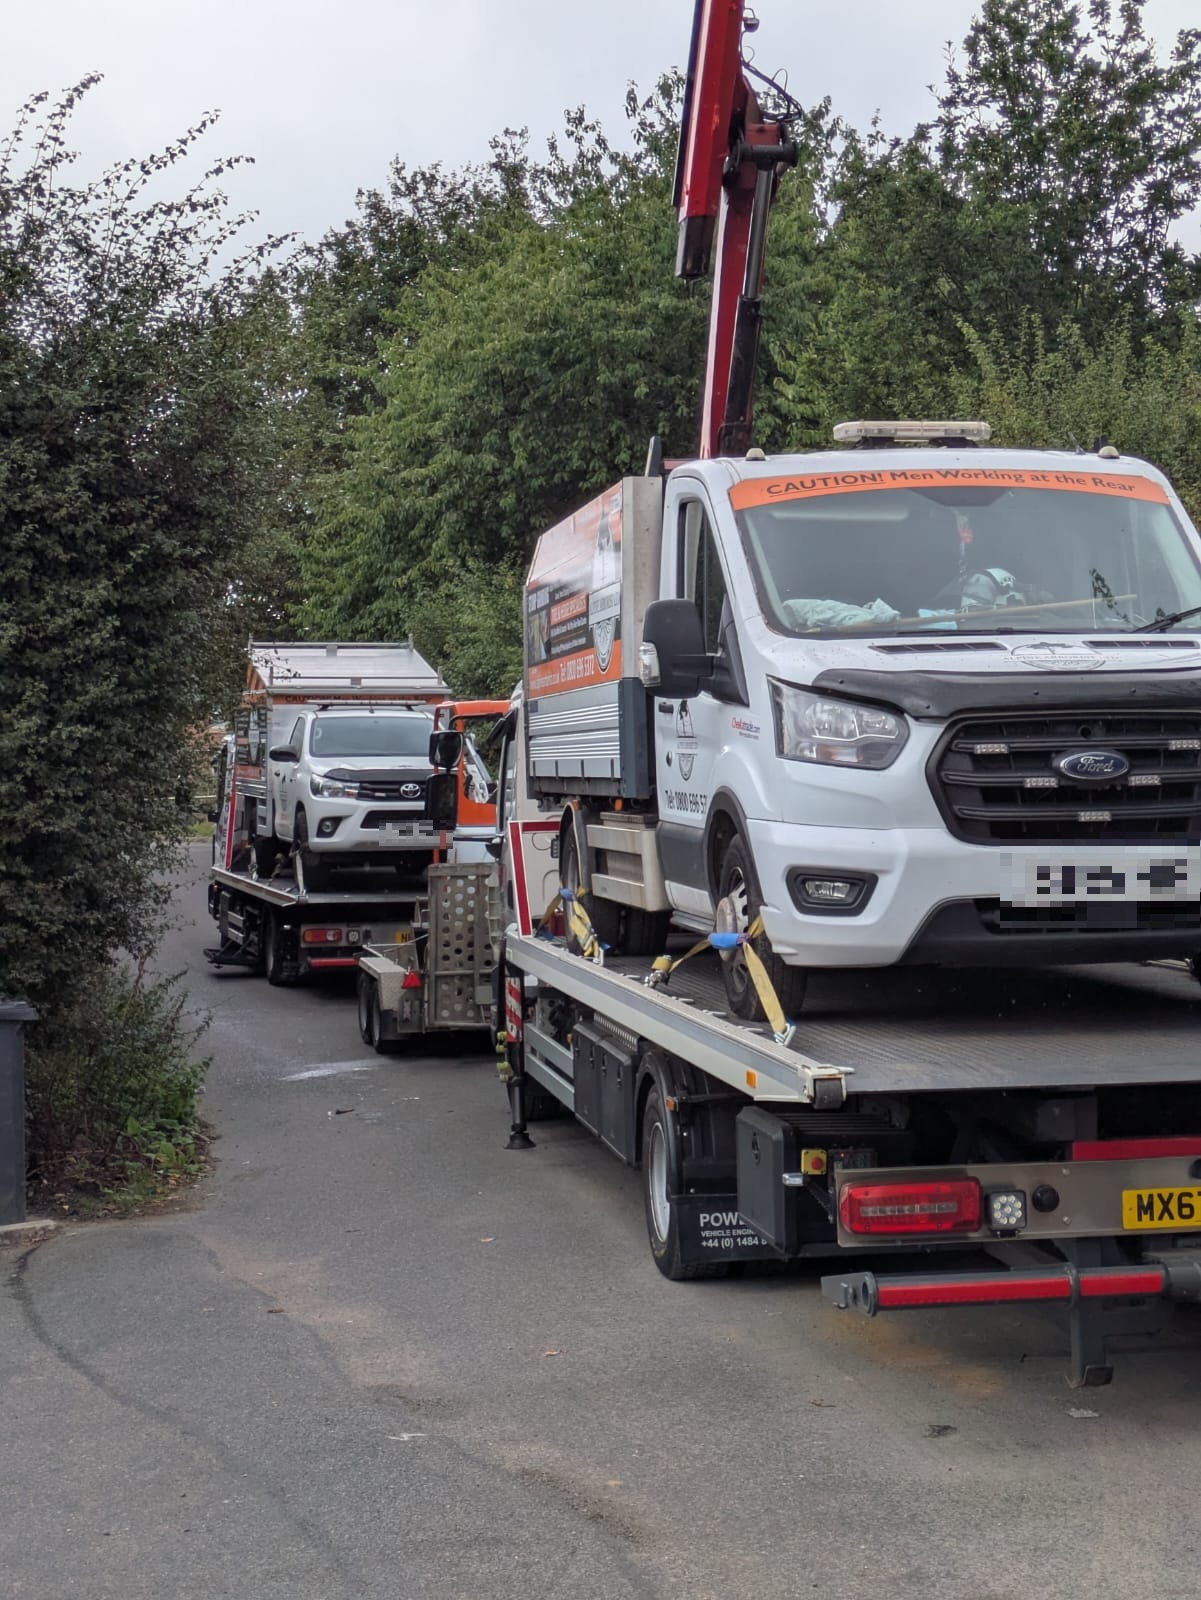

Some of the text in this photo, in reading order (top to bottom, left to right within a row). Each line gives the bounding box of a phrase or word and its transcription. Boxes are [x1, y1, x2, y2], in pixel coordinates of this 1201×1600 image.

[766, 470, 1136, 494] CAUTION! Men Working at the Rear
[1077, 755, 1114, 772] Ford
[1136, 1191, 1201, 1222] MX6
[701, 1229, 731, 1237] VEHICLE
[701, 1239, 719, 1248] +44
[721, 1238, 734, 1249] (0)
[736, 1236, 759, 1247] 1484
